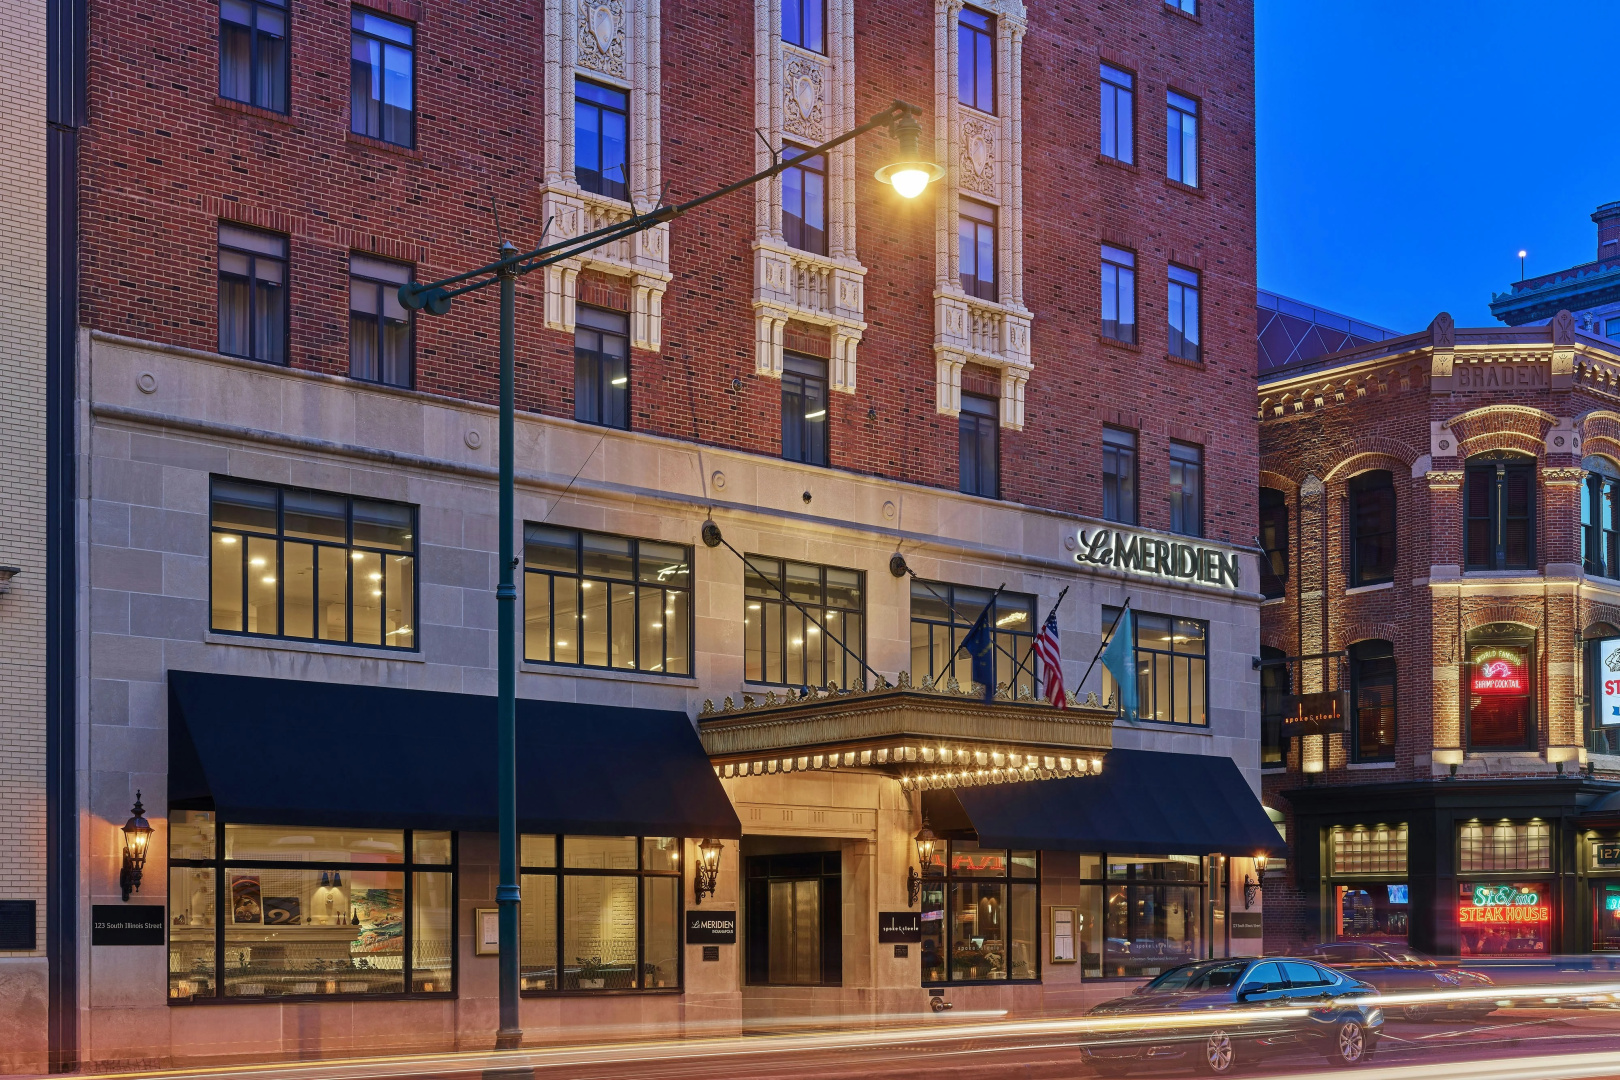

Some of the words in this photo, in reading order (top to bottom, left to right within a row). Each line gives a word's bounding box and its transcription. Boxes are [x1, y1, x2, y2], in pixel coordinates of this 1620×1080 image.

[1076, 529, 1113, 565] Le
[1113, 532, 1238, 588] MERIDIEN
[1475, 650, 1497, 664] WORLD
[1498, 650, 1522, 666] FAMOUS
[1475, 680, 1495, 689] SHRIMP
[1495, 679, 1522, 689] COCKTAIL
[1285, 703, 1309, 724] spoke
[1315, 699, 1341, 721] steele
[1460, 906, 1504, 922] STEAK
[1505, 906, 1548, 921] HOUSE
[690, 920, 700, 929] Le
[700, 920, 734, 929] MERIDIEN
